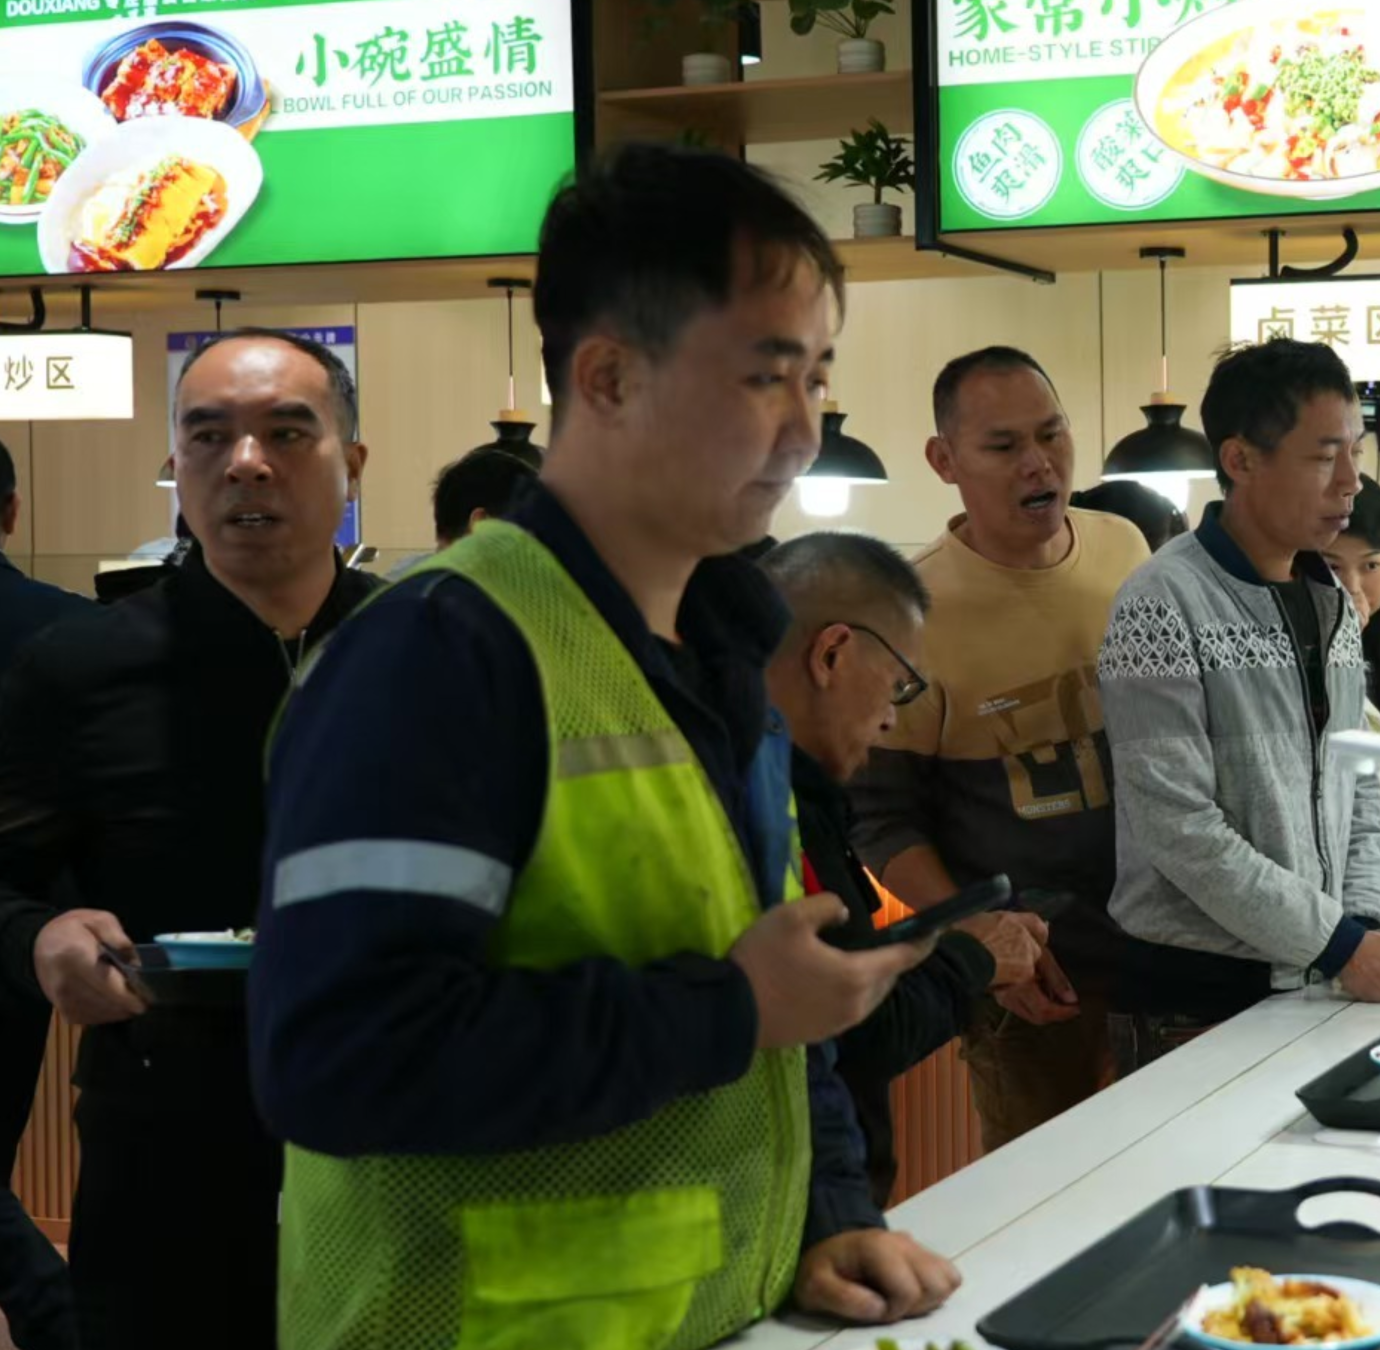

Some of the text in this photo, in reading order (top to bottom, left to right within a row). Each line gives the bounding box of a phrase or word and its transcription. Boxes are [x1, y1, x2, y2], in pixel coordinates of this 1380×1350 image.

[6, 0, 100, 17] DOUXIANG
[294, 15, 544, 88] 小碗盛情
[949, 41, 1104, 67] HOME-STYLE
[283, 81, 552, 114] BOWL FULL OF OUR PASSION
[3, 354, 75, 391] 炒区
